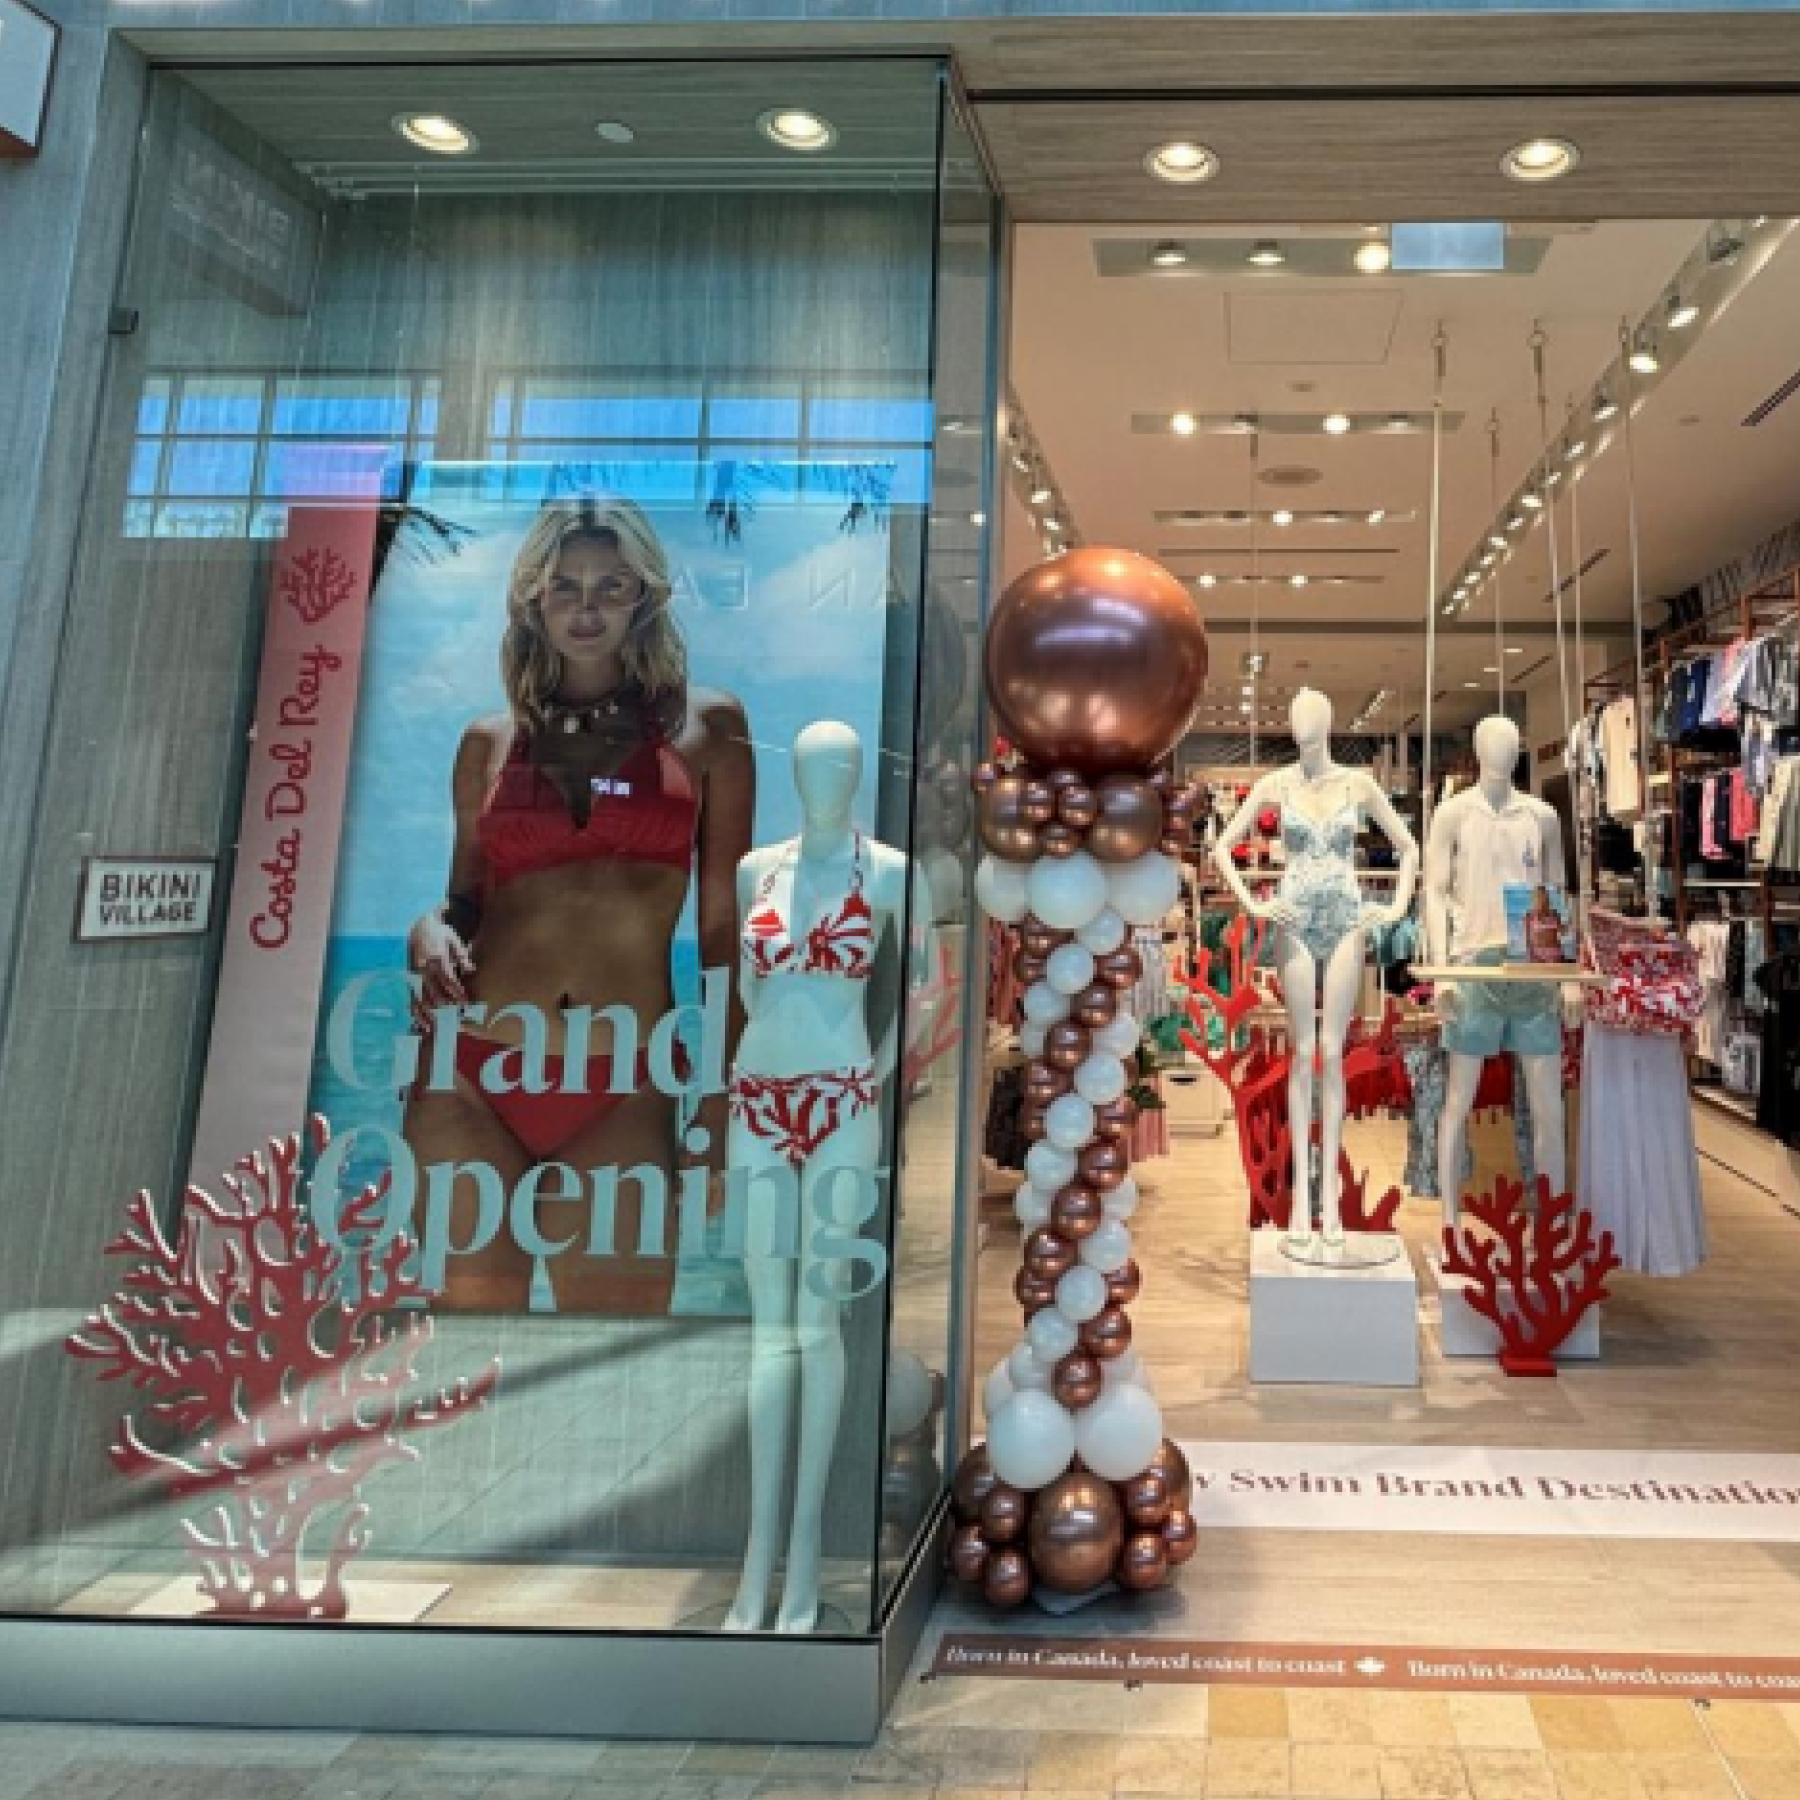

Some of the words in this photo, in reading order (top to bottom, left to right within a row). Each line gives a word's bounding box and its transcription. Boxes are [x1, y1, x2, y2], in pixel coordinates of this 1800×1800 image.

[276, 641, 342, 728] Rey
[264, 737, 312, 821] Del
[99, 902, 198, 926] VILLAGE
[102, 873, 202, 901] BIKINI
[248, 827, 303, 949] Costa
[328, 965, 731, 1097] Grand
[310, 1122, 893, 1301] Opening
[1226, 1468, 1362, 1493] Swim
[1375, 1472, 1527, 1498] Brand
